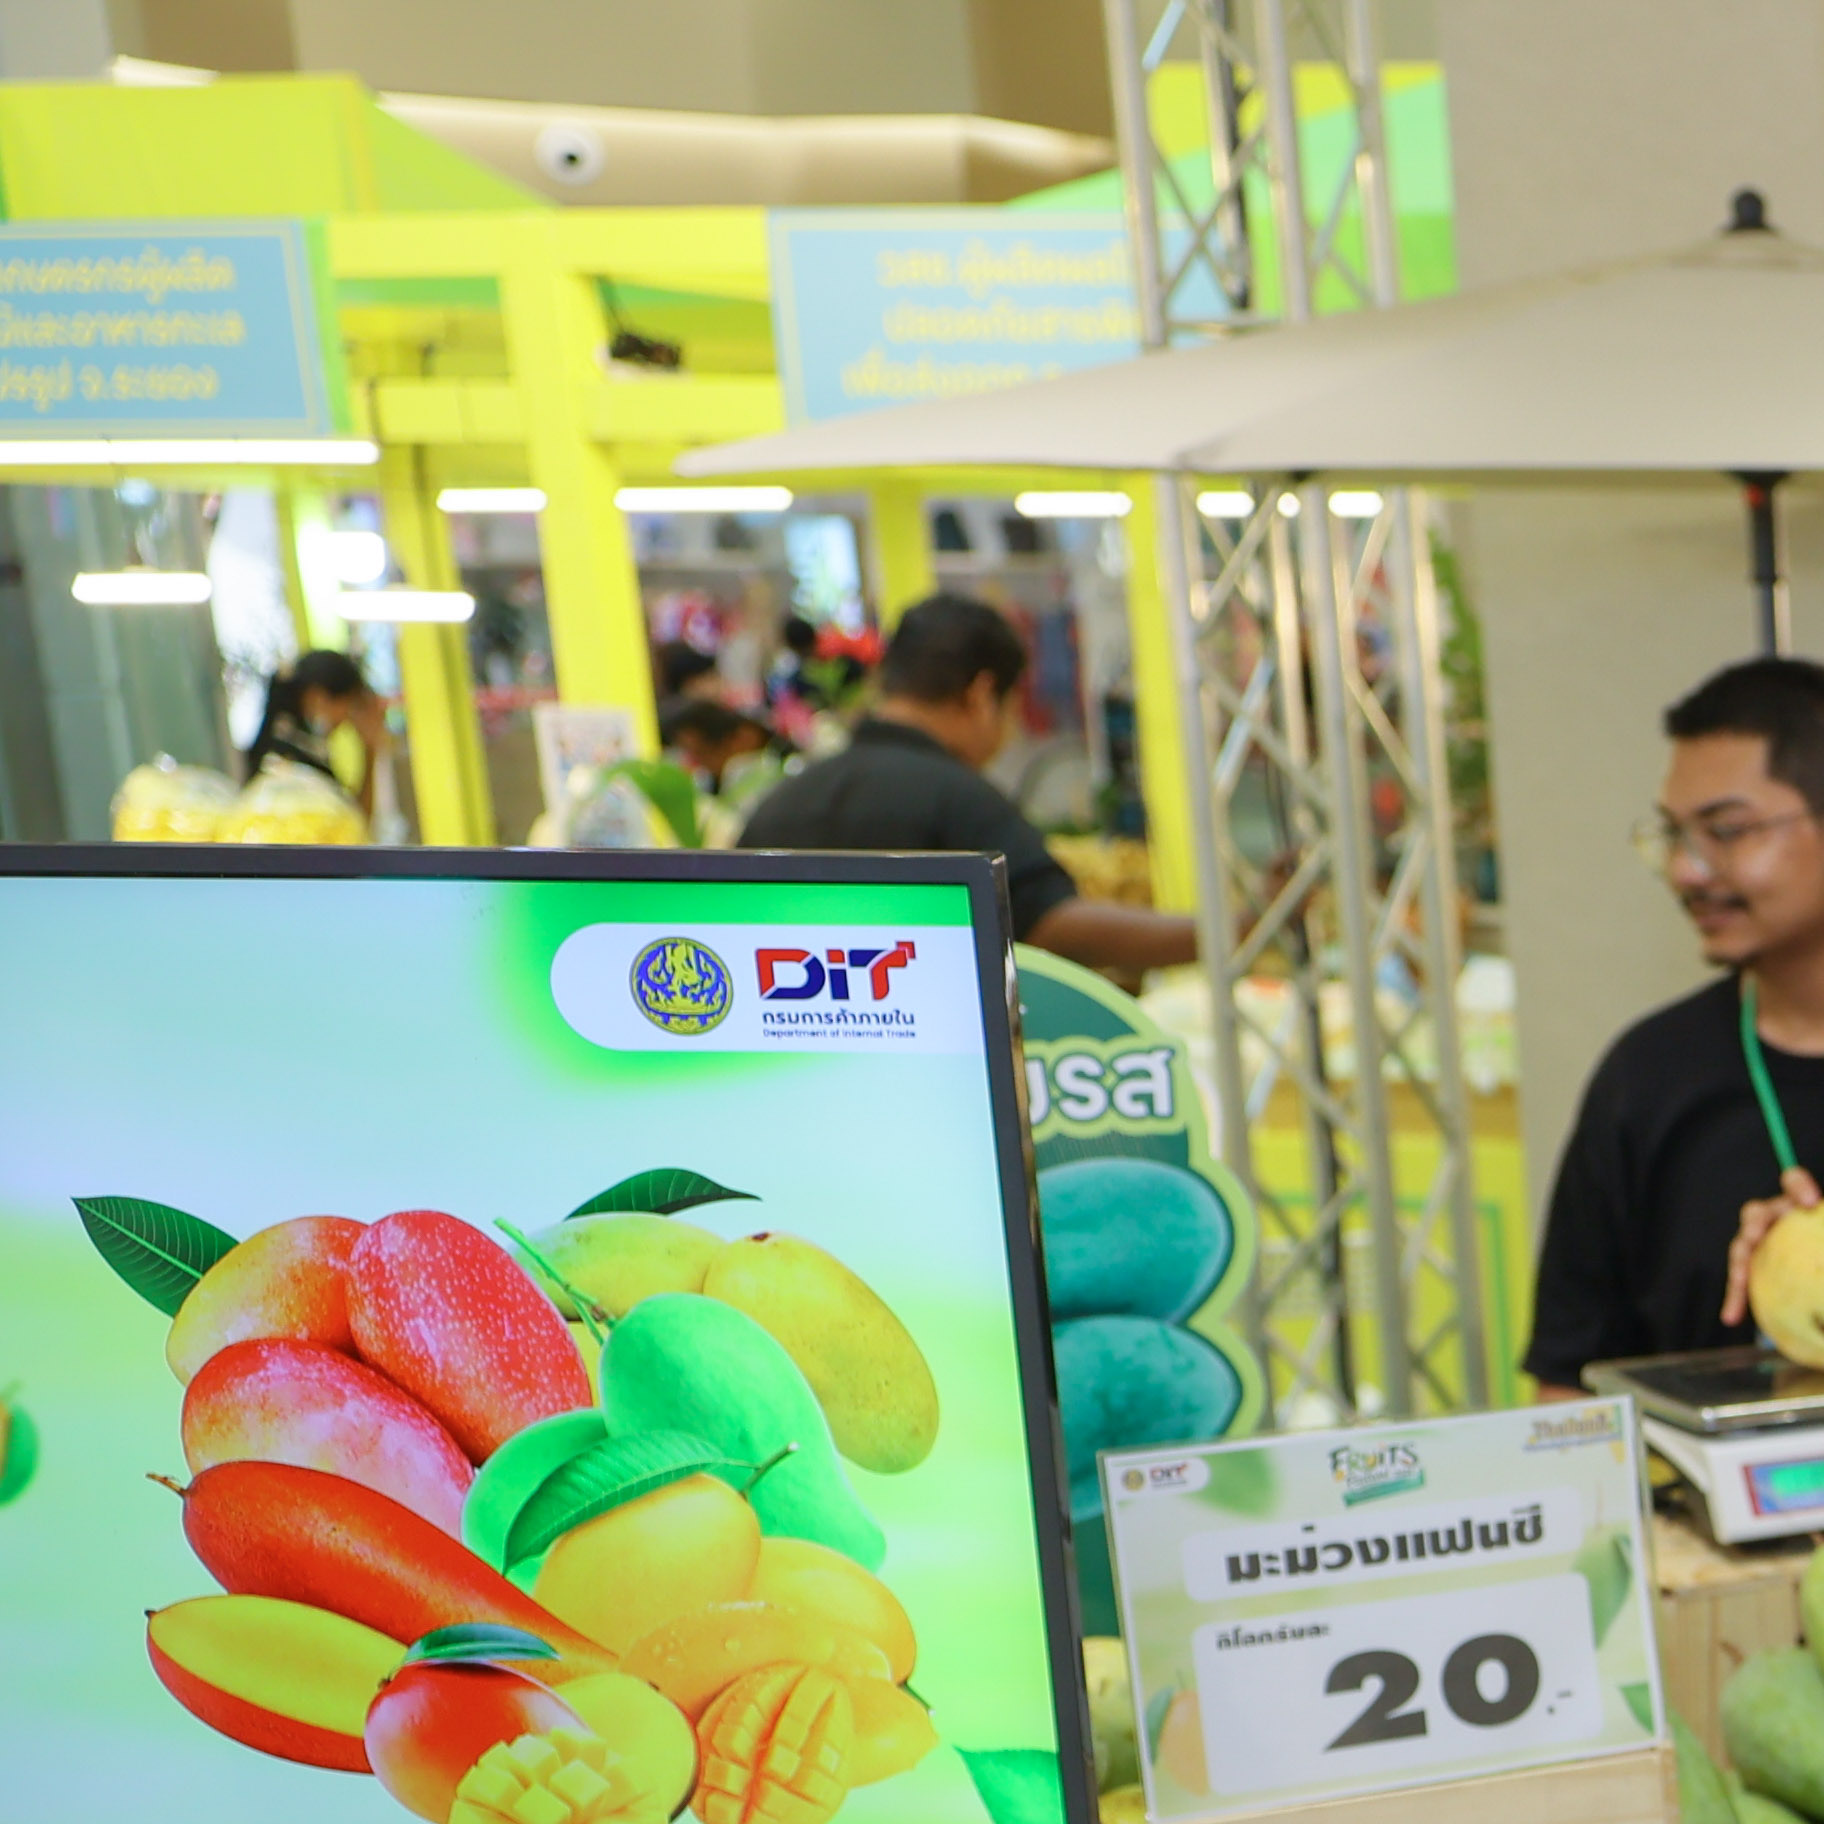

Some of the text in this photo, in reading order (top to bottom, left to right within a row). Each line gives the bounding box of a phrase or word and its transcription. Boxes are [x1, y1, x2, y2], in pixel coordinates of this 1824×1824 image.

[763, 1008, 915, 1026] กรมการค้าภายใน
[763, 1029, 828, 1039] Department
[830, 1029, 840, 1038] of
[887, 1029, 916, 1038] Trade
[1225, 1503, 1545, 1584] มะม่วงแฟนซี
